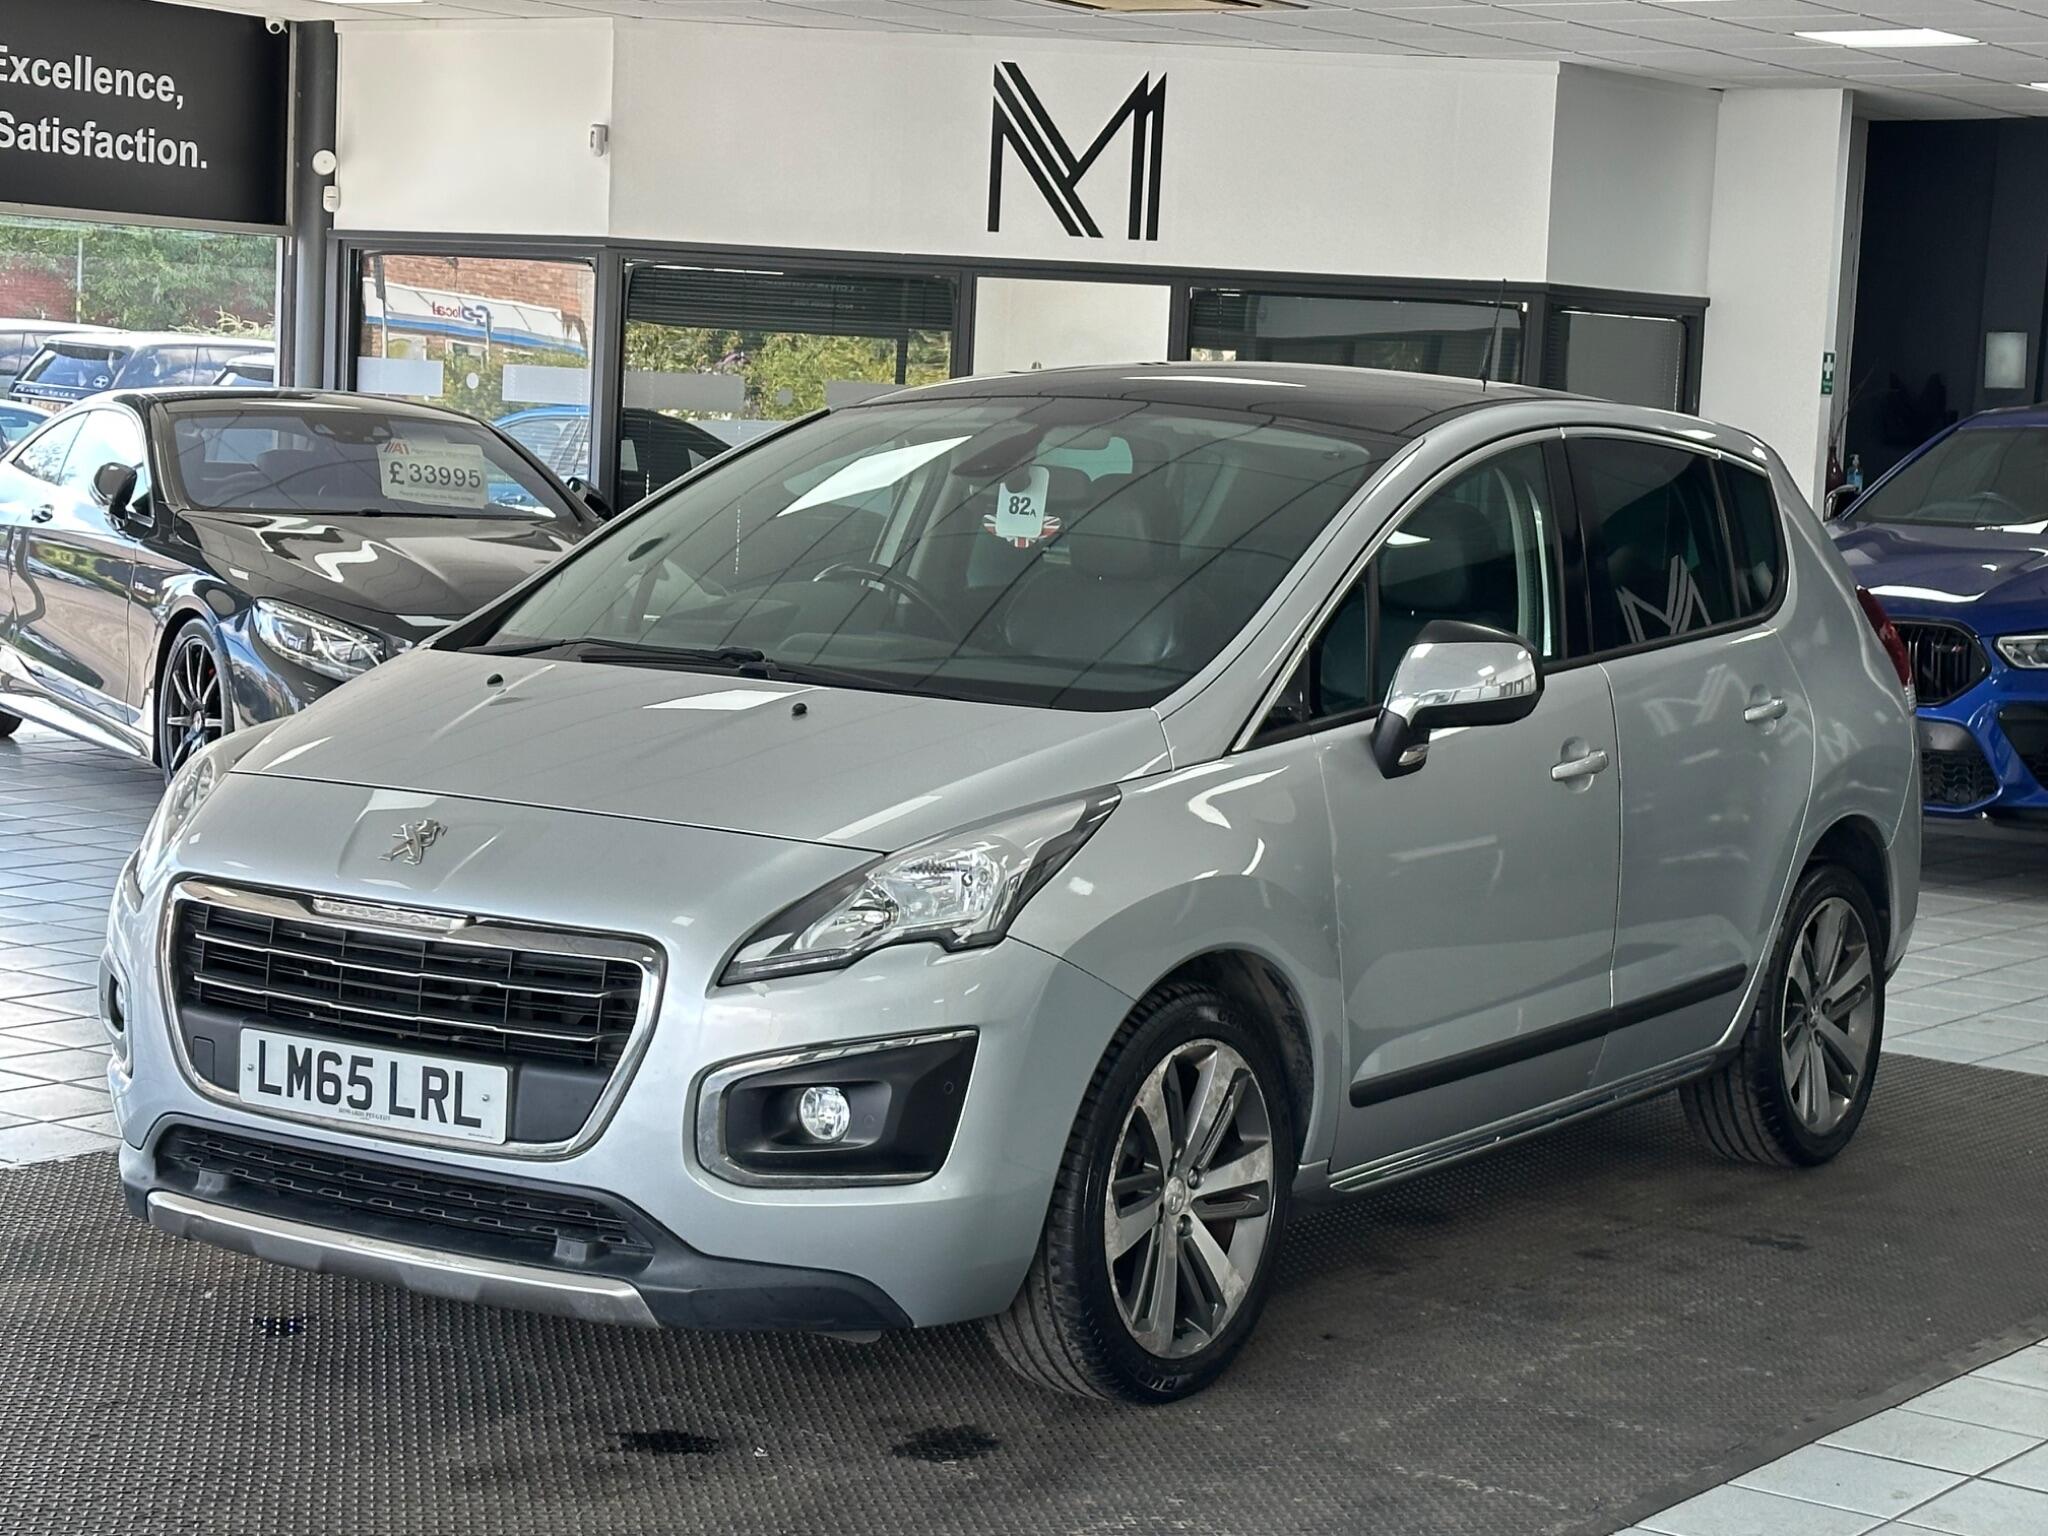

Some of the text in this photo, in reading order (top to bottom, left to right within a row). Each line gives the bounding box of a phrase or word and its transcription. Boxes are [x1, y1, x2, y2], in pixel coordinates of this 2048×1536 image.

[0, 110, 208, 169] Satisfaction.
[389, 461, 481, 489] £33995
[258, 1039, 482, 1129] LM65 LRL
